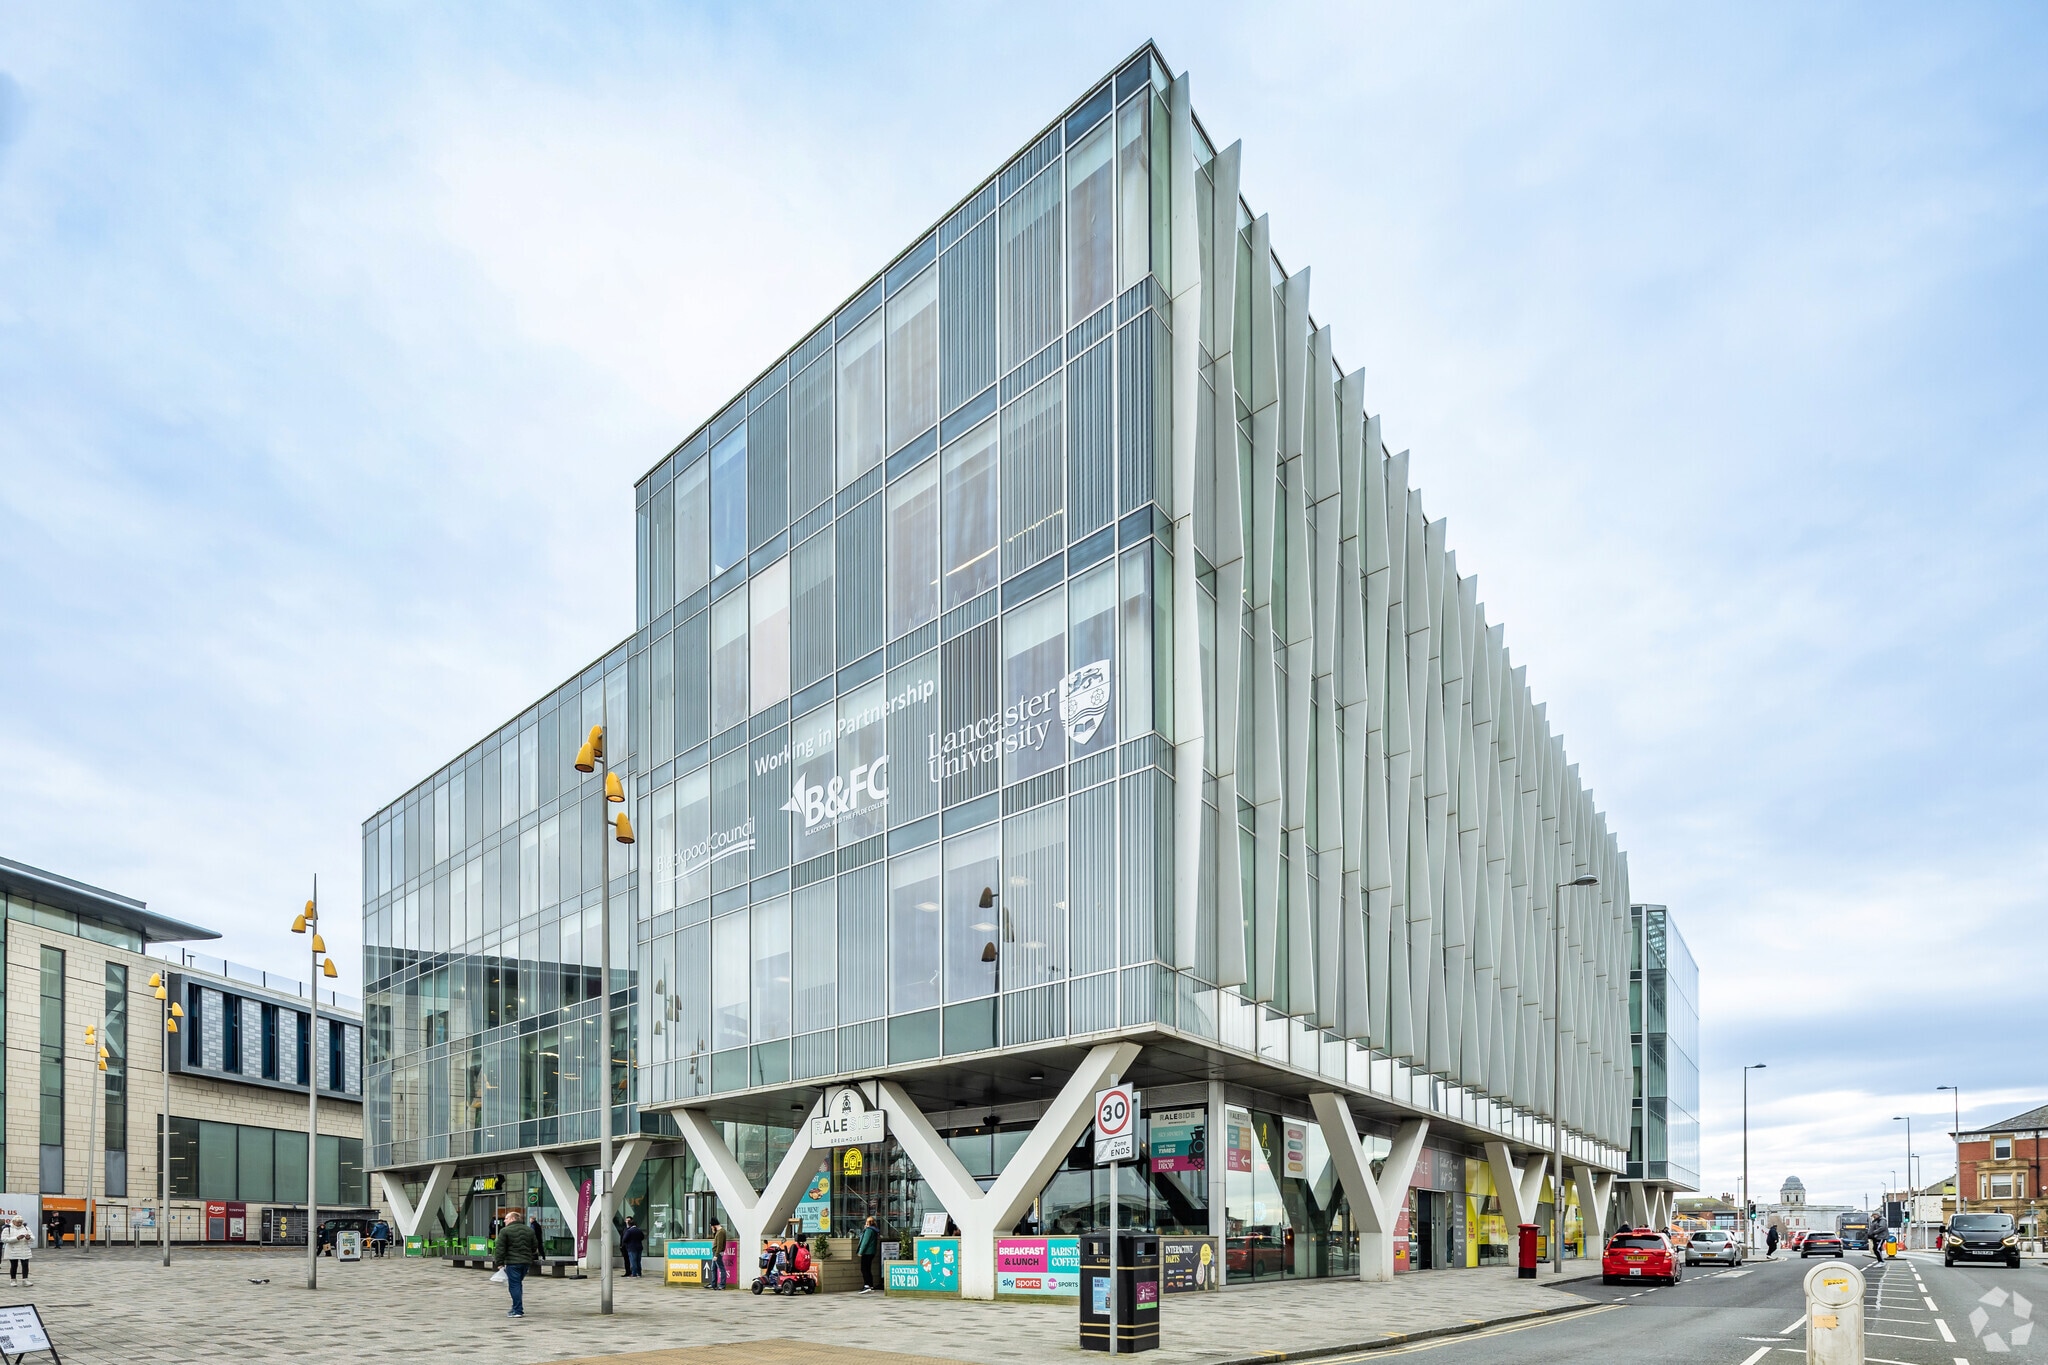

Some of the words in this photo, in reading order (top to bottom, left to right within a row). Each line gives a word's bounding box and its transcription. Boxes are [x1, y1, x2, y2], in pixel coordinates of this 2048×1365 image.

[755, 737, 815, 777] Working
[819, 728, 832, 748] in
[837, 679, 935, 739] Partnership
[928, 688, 1057, 760] Lancaster
[928, 719, 1052, 783] University
[806, 755, 890, 828] B&FC
[805, 822, 832, 837] BLACKPOOL
[832, 818, 843, 827] AD
[868, 800, 890, 812] COLLEE
[1102, 1101, 1126, 1122] 30
[1159, 1111, 1195, 1121] RALESIDE
[815, 1113, 881, 1136] RALESIDE
[830, 1135, 863, 1143] BREWHOUSE
[1110, 1146, 1130, 1157] ENDS
[473, 1178, 498, 1191] SUBWAY
[670, 1247, 700, 1256] INDEPENDENT
[700, 1247, 710, 1256] PUB
[999, 1246, 1045, 1256] BREAKFAST
[1165, 1245, 1194, 1254] INTERACTIVE
[1004, 1258, 1011, 1266] &
[1012, 1258, 1039, 1266] LUNCH
[1051, 1257, 1080, 1267] COFFEE
[1165, 1254, 1180, 1264] DARTS
[891, 1275, 906, 1287] FOR
[906, 1275, 919, 1287] £10
[1002, 1278, 1015, 1288] sky
[1016, 1279, 1041, 1288] sports
